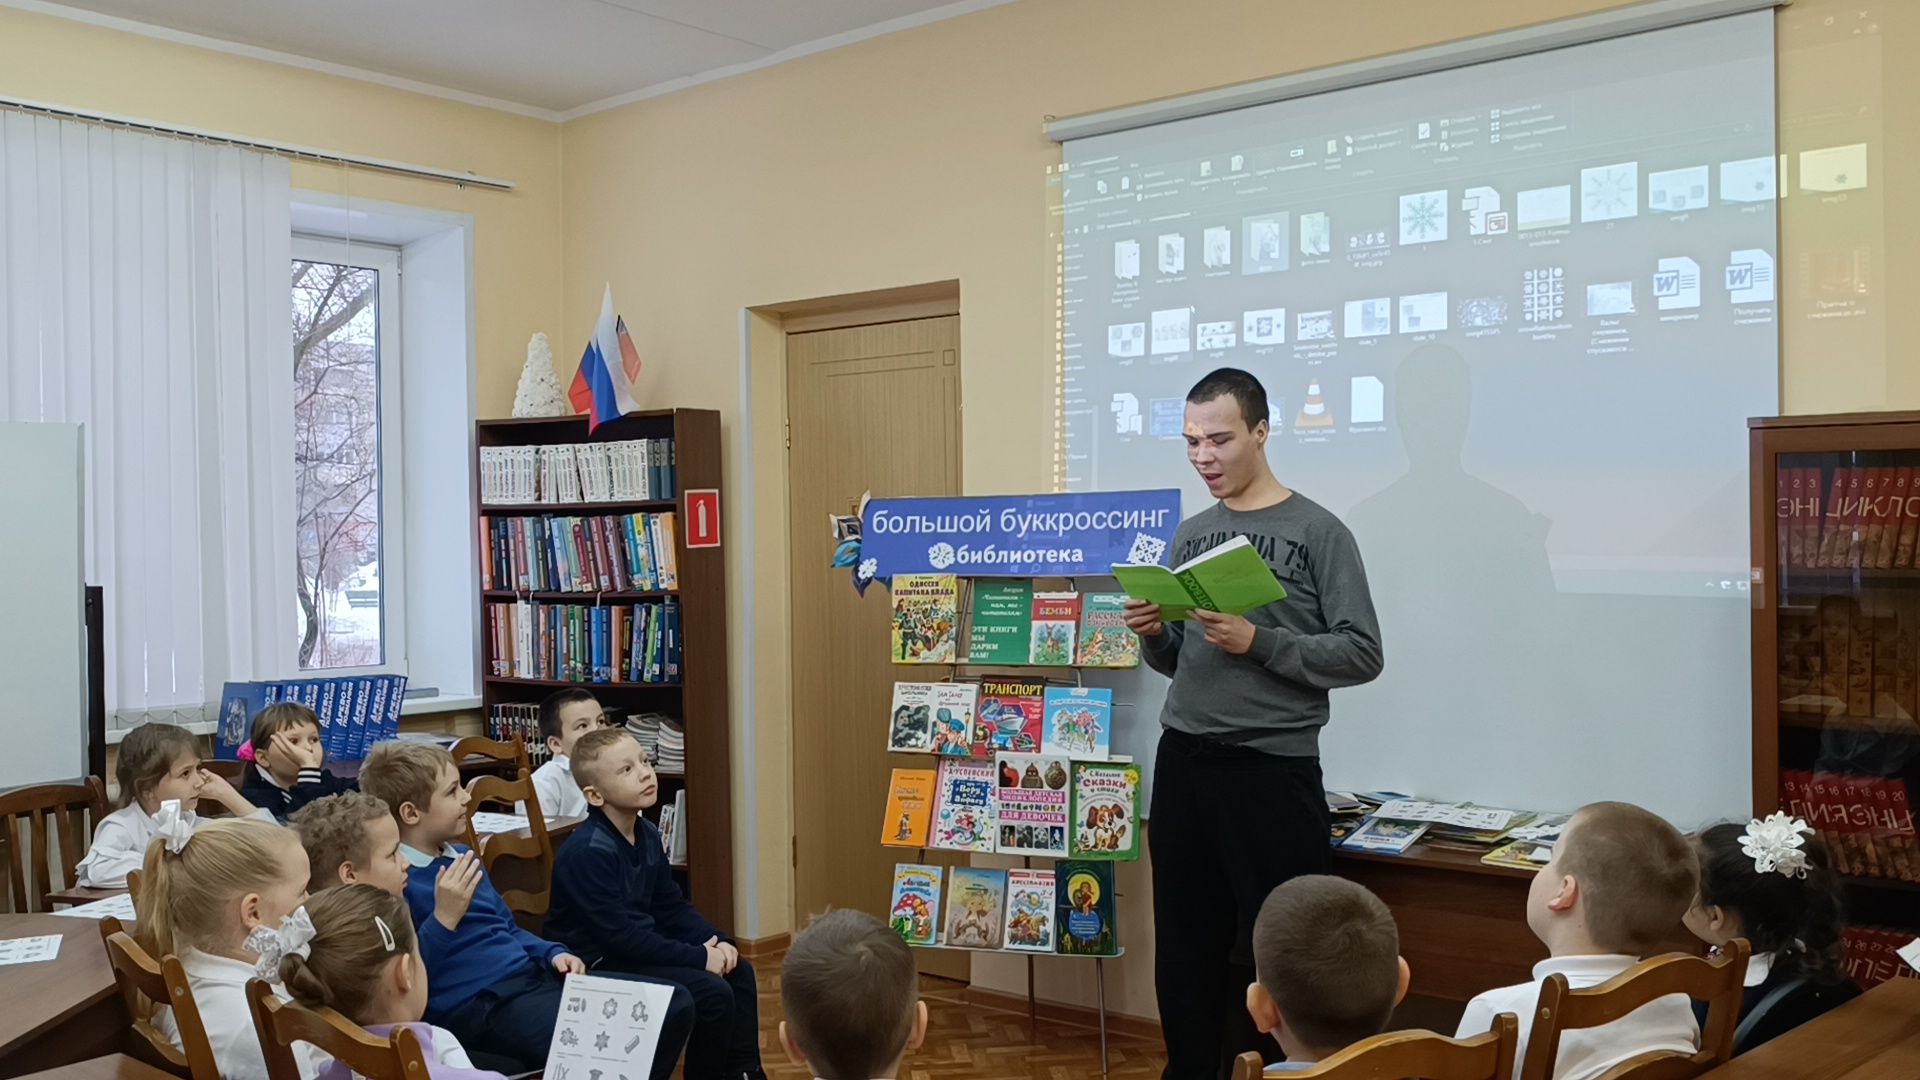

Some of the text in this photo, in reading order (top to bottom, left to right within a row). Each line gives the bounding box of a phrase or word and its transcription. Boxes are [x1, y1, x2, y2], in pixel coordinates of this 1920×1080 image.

[1793, 478, 1801, 489] 2
[1809, 478, 1817, 489] 3
[1835, 478, 1842, 489] 4
[1850, 478, 1858, 488] 5
[1866, 478, 1874, 488] 6
[1882, 477, 1890, 487] 7
[1896, 477, 1904, 487] 8
[872, 507, 1170, 538] большой буккроссинг
[956, 544, 1084, 565] библиотека
[1284, 539, 1310, 572] 79
[909, 580, 940, 588] ОДИССЕЯ
[1180, 568, 1216, 611] OTEBOOK
[1040, 607, 1072, 616] БЕМБИ
[990, 625, 1018, 633] КНИГИ
[971, 634, 986, 642] МЫ
[970, 643, 999, 651] ДАРИМ
[983, 682, 1043, 696] ТРАНСПОРТ
[1784, 781, 1905, 802] 13 14 15 16 17 18 19 20
[1001, 811, 1063, 823] ДЛЯ ДЕВОЧЕК
